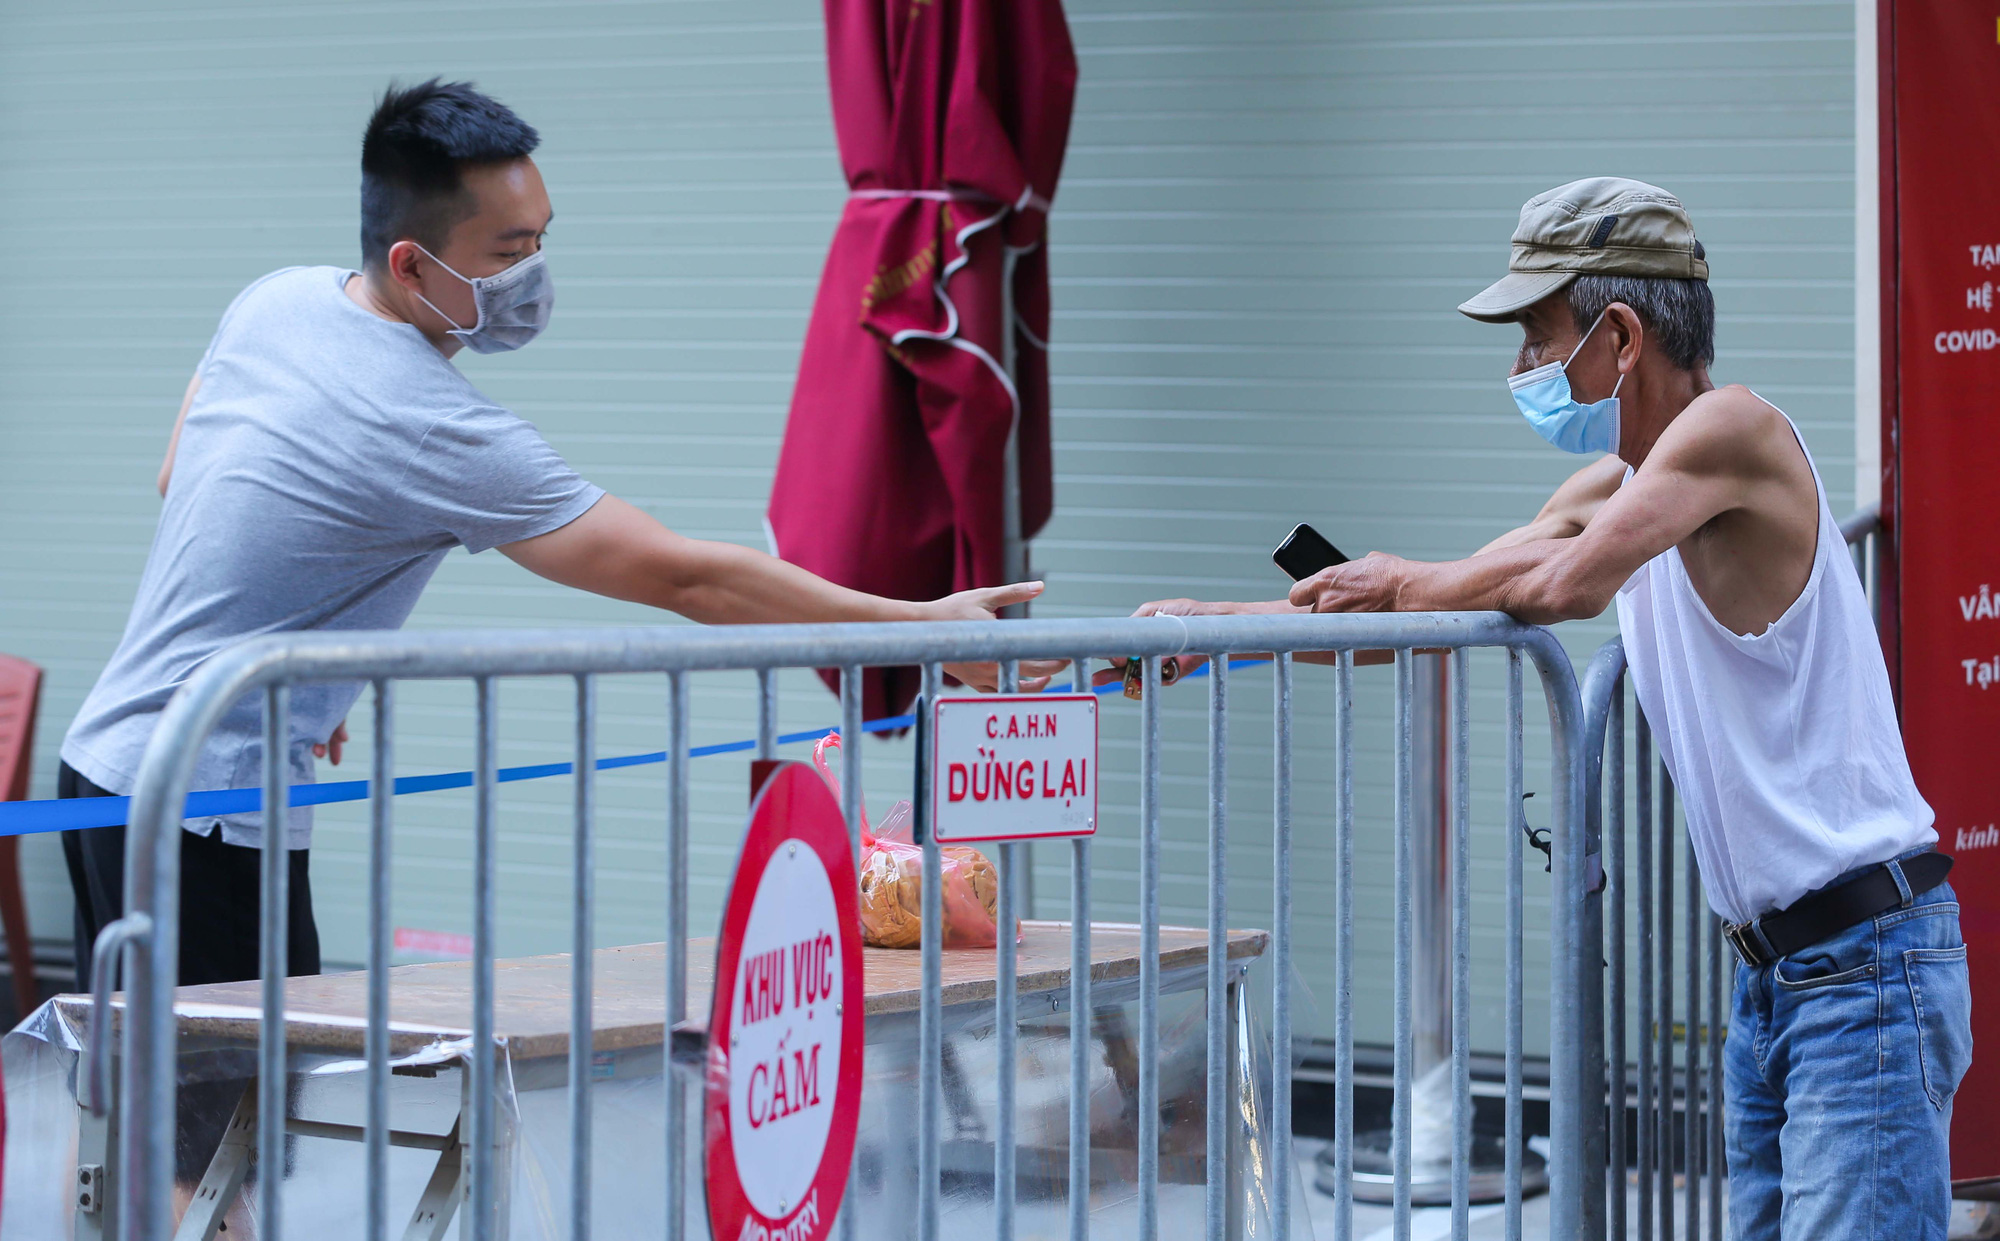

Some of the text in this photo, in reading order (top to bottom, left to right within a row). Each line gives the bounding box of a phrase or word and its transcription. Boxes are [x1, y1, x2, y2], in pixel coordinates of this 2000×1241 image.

[1969, 244, 2000, 270] TẠ
[1967, 281, 1993, 313] HỆ
[1961, 655, 2000, 690] Tại
[986, 713, 1057, 739] C.A.H.N
[948, 744, 1087, 808] DỪNG LẠI
[1955, 823, 1999, 851] kính
[742, 928, 833, 1026] KHU VỰC
[748, 1027, 821, 1129] CẤM
